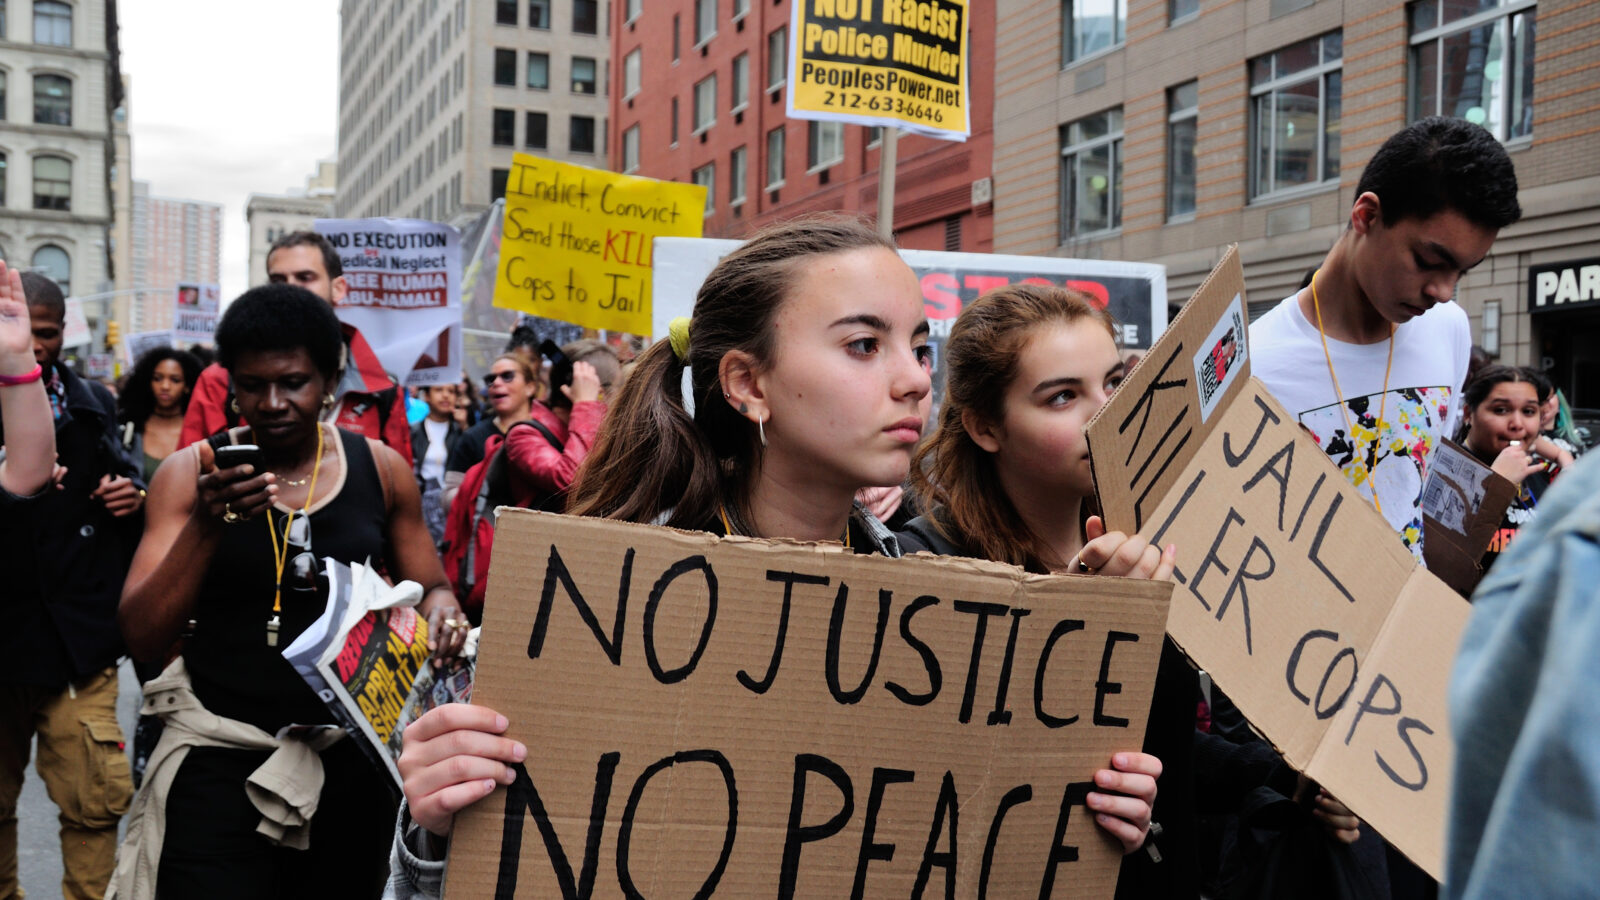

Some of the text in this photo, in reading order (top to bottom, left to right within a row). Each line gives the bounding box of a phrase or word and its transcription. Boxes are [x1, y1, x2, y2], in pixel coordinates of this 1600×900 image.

[882, 0, 958, 42] Racist
[805, 23, 960, 78] Police Murder
[802, 62, 961, 108] PeoplesPower.net
[823, 91, 943, 123] 212-633-6646
[600, 184, 680, 224] Convict
[327, 232, 447, 249] NO EXECUTION
[503, 207, 553, 248] Send
[557, 221, 601, 255] those
[342, 255, 446, 272] edical Neglect
[344, 272, 446, 290] REE MUMIA
[506, 256, 646, 313] Cops to Jail
[1536, 264, 1600, 307] PAR
[339, 290, 440, 305] ABU-JAMAL!
[920, 272, 1109, 320] STP
[1223, 394, 1355, 602] JAIL
[527, 543, 1140, 730] NO JUSTICE
[357, 657, 394, 724] APRIL
[386, 631, 408, 664] 14
[372, 679, 405, 744] SHUT
[396, 658, 415, 693] IT
[1286, 630, 1434, 791] COPS
[495, 749, 739, 900] NO
